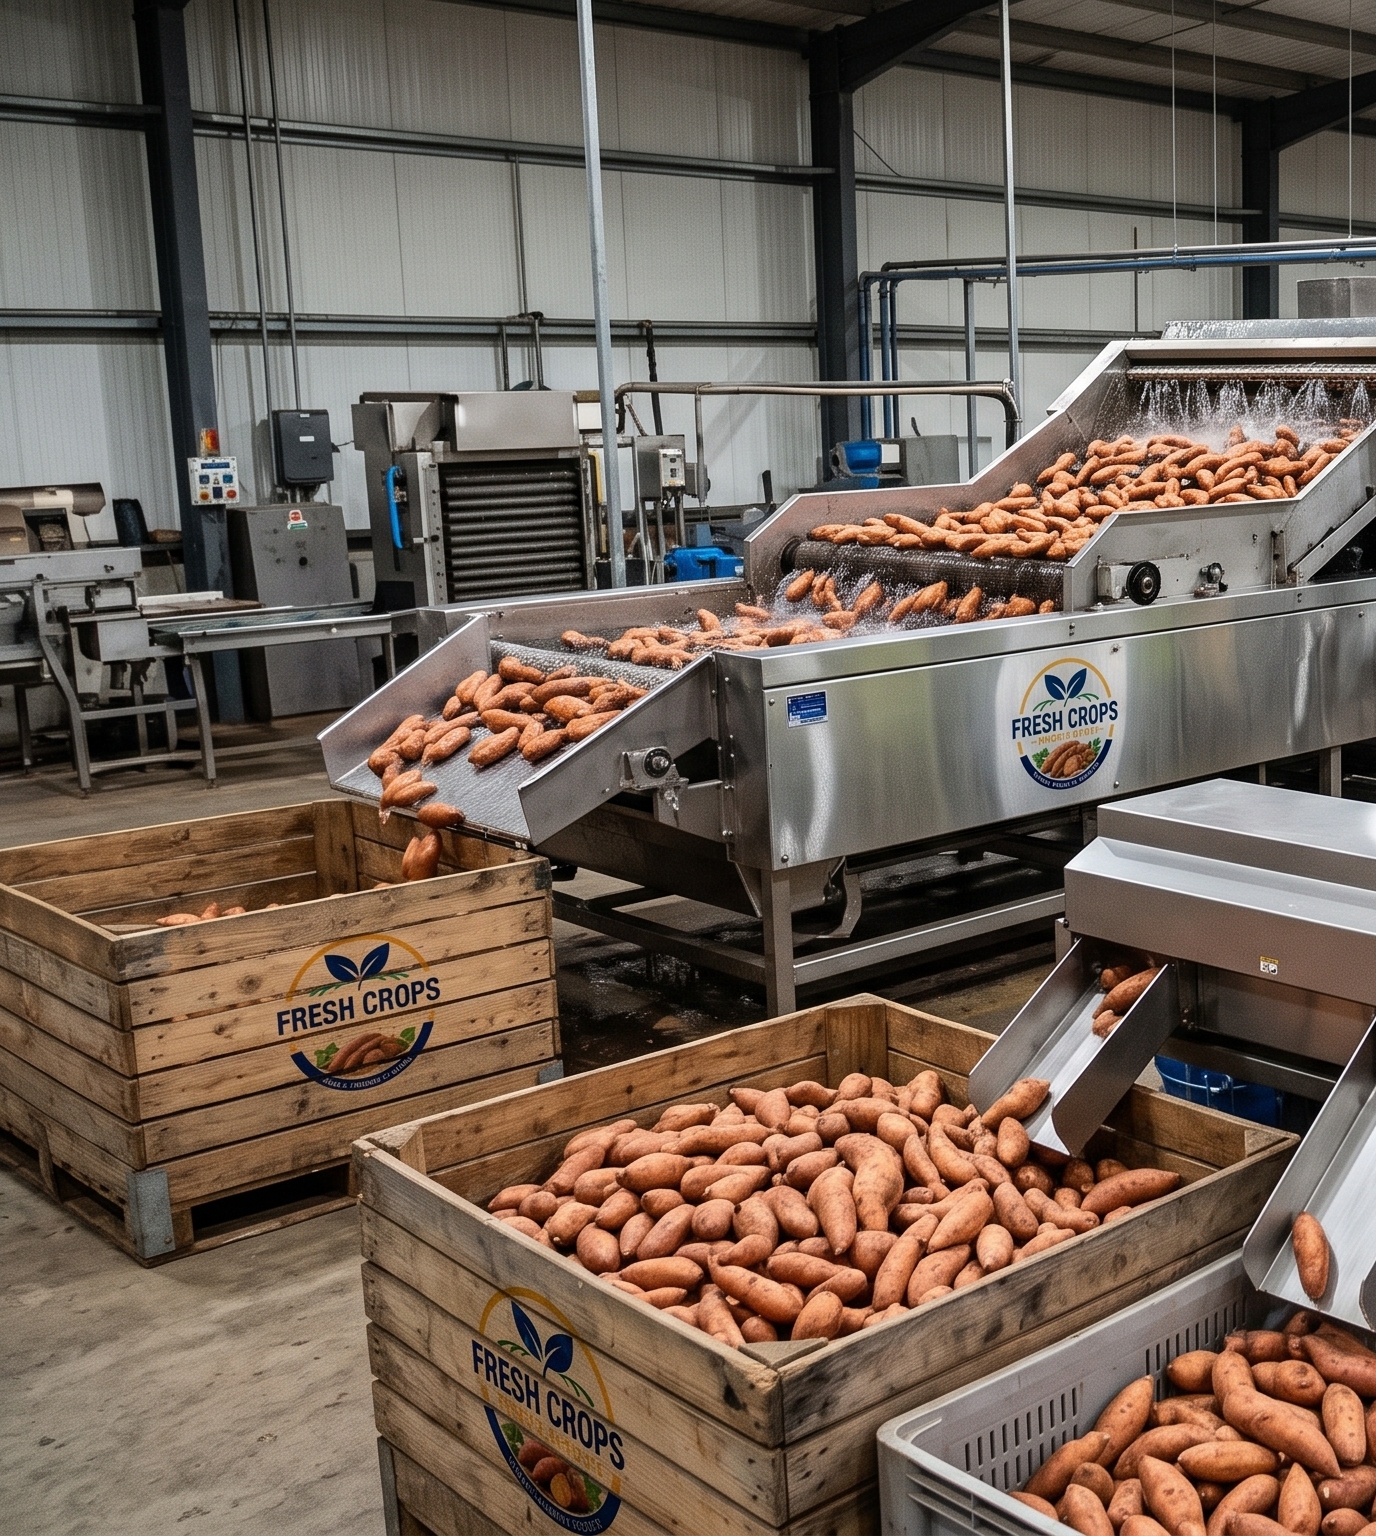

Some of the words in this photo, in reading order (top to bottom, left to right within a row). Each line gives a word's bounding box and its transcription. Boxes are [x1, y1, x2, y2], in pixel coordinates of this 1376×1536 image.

[1012, 710, 1063, 740] FRESH
[1068, 701, 1119, 729] CROPS
[276, 996, 355, 1036] FRESH
[362, 977, 441, 1015] CROPS
[471, 1339, 541, 1416] FRESH
[546, 1390, 625, 1471] CROPS
